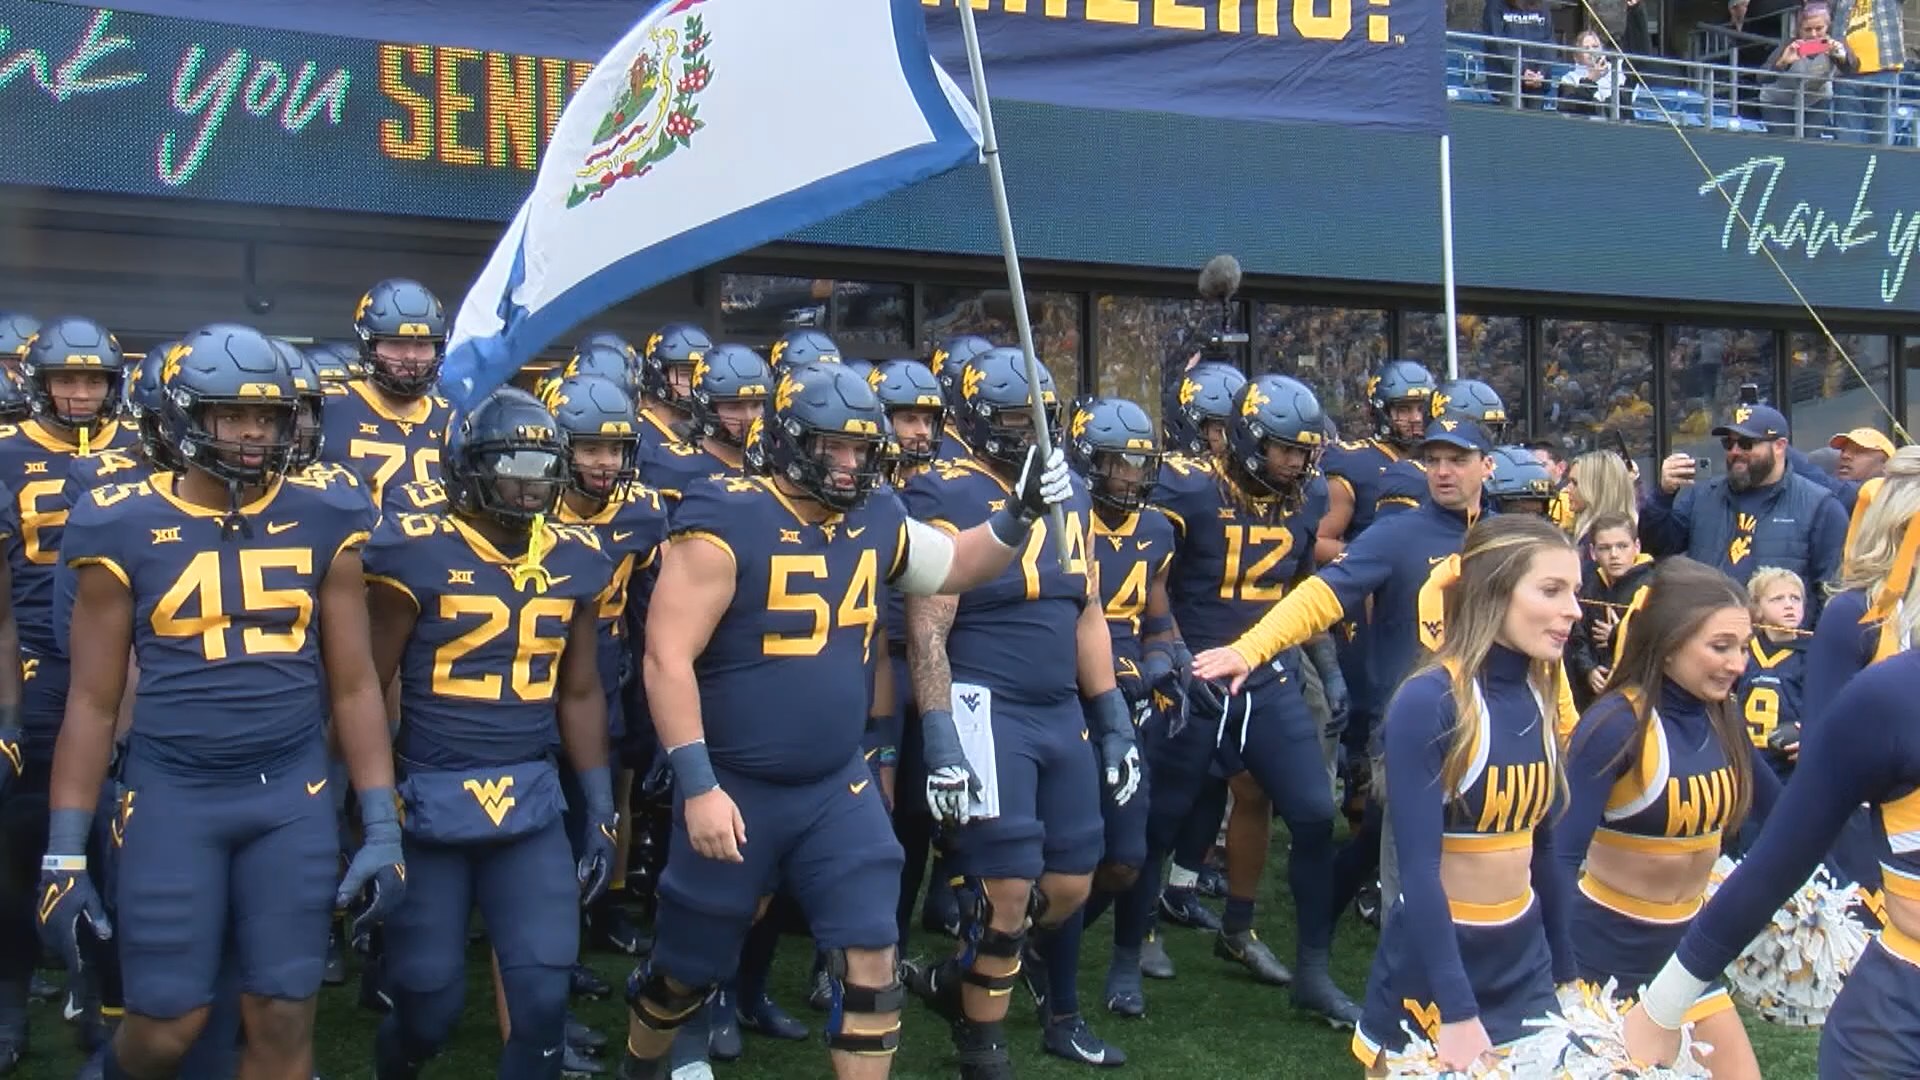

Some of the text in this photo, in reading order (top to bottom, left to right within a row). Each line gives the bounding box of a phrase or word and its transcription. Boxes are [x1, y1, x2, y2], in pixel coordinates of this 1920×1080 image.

[155, 43, 351, 186] you
[379, 44, 596, 171] SENI
[1699, 155, 1878, 258] Thank
[151, 548, 313, 661] 45
[763, 548, 878, 664] 54
[1093, 560, 1147, 635] 4
[1221, 525, 1294, 600] 12
[433, 595, 575, 700] 26
[1745, 686, 1779, 748] 9
